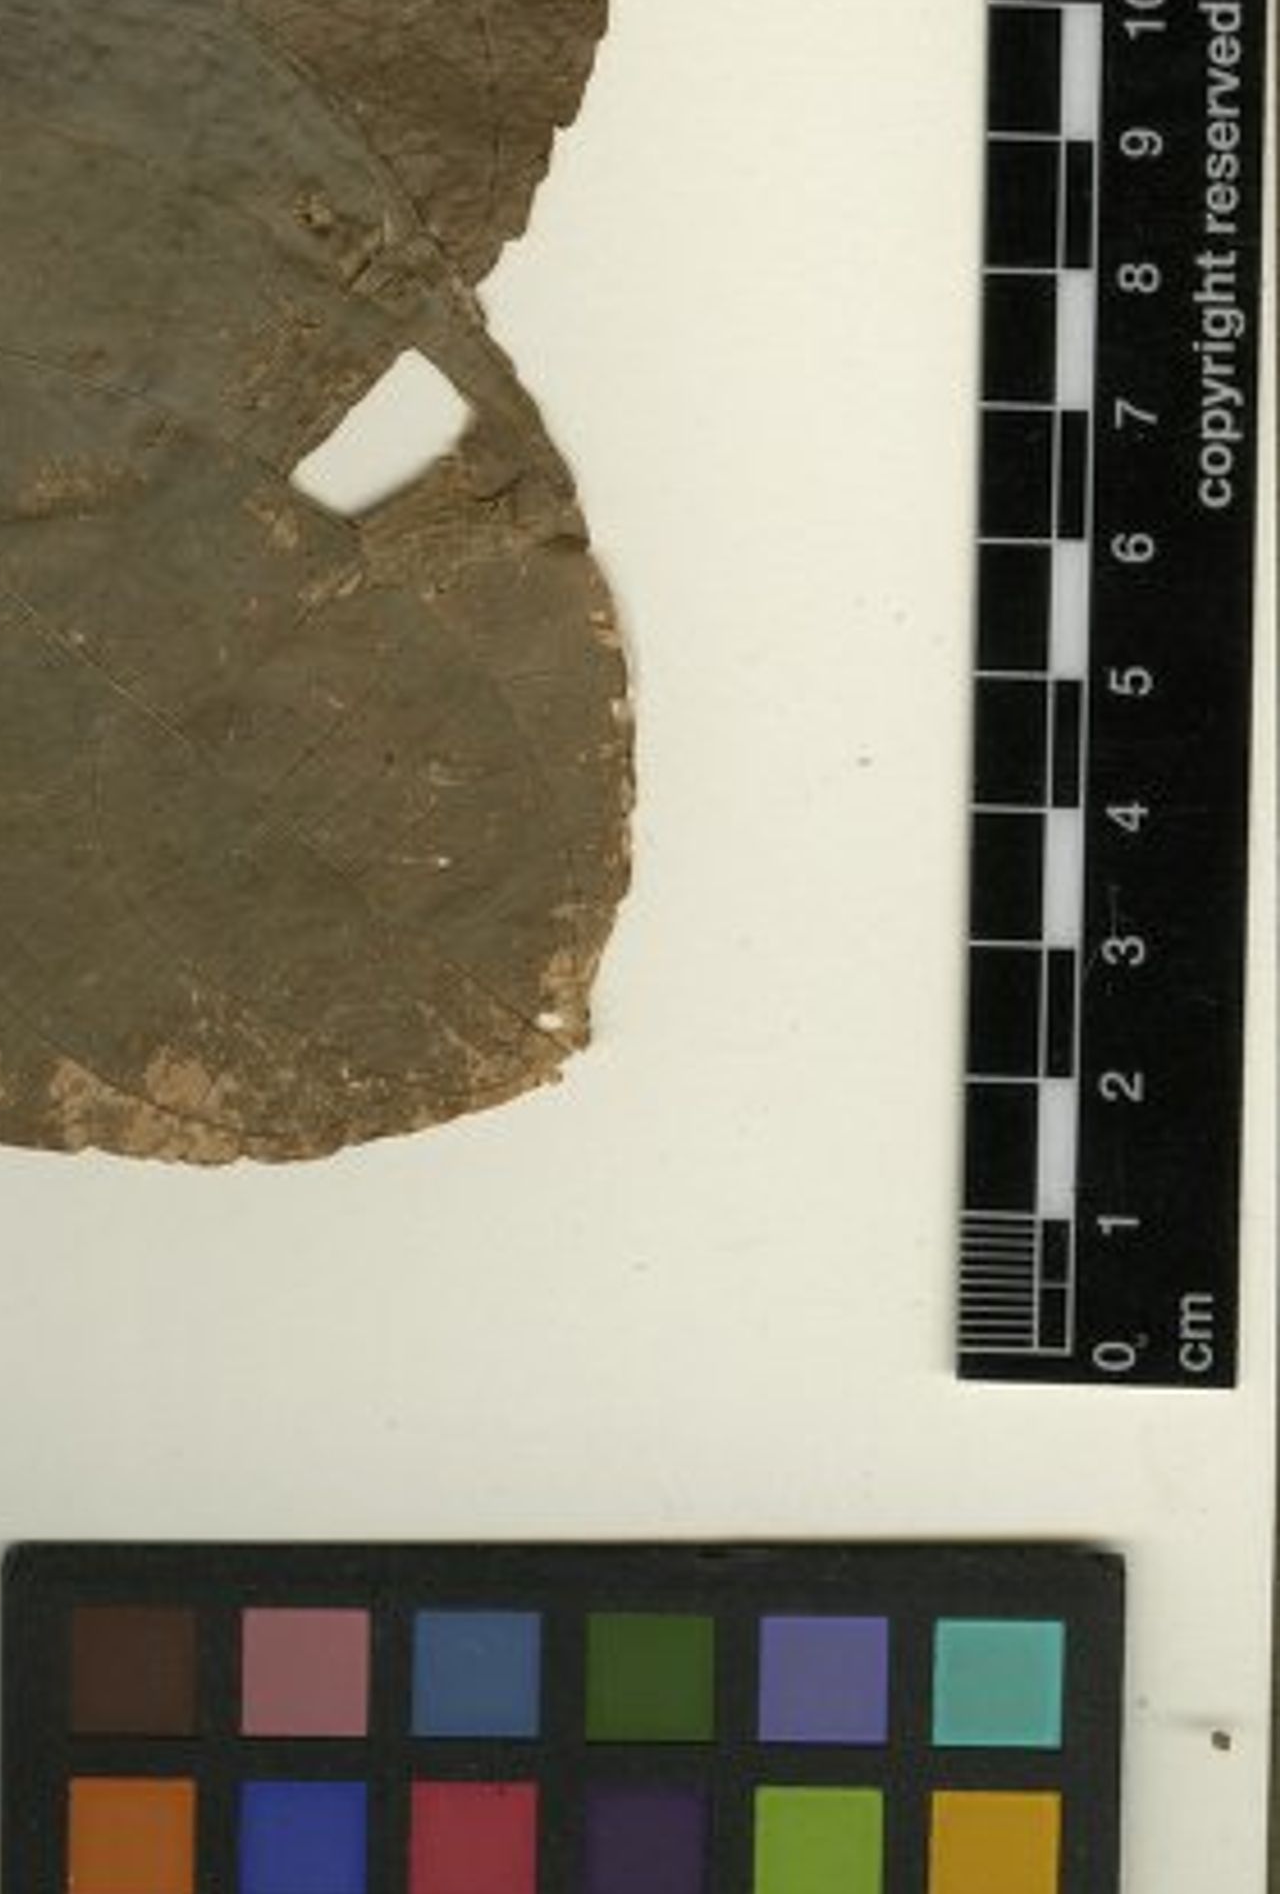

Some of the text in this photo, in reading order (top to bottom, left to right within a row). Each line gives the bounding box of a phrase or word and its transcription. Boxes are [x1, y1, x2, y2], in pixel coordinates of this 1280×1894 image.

[1119, 127, 1163, 158] 9
[1192, 1, 1246, 509] copyright reserved
[1117, 262, 1161, 294] 8
[1114, 398, 1158, 429] 7
[1110, 533, 1155, 563] 6
[1108, 666, 1153, 696] 5
[1105, 802, 1149, 832] 4
[1101, 935, 1146, 966] 3
[1098, 1071, 1143, 1102] 2
[1096, 1215, 1140, 1235] 1
[1178, 1293, 1214, 1373] cm
[1092, 1341, 1136, 1372] 0
